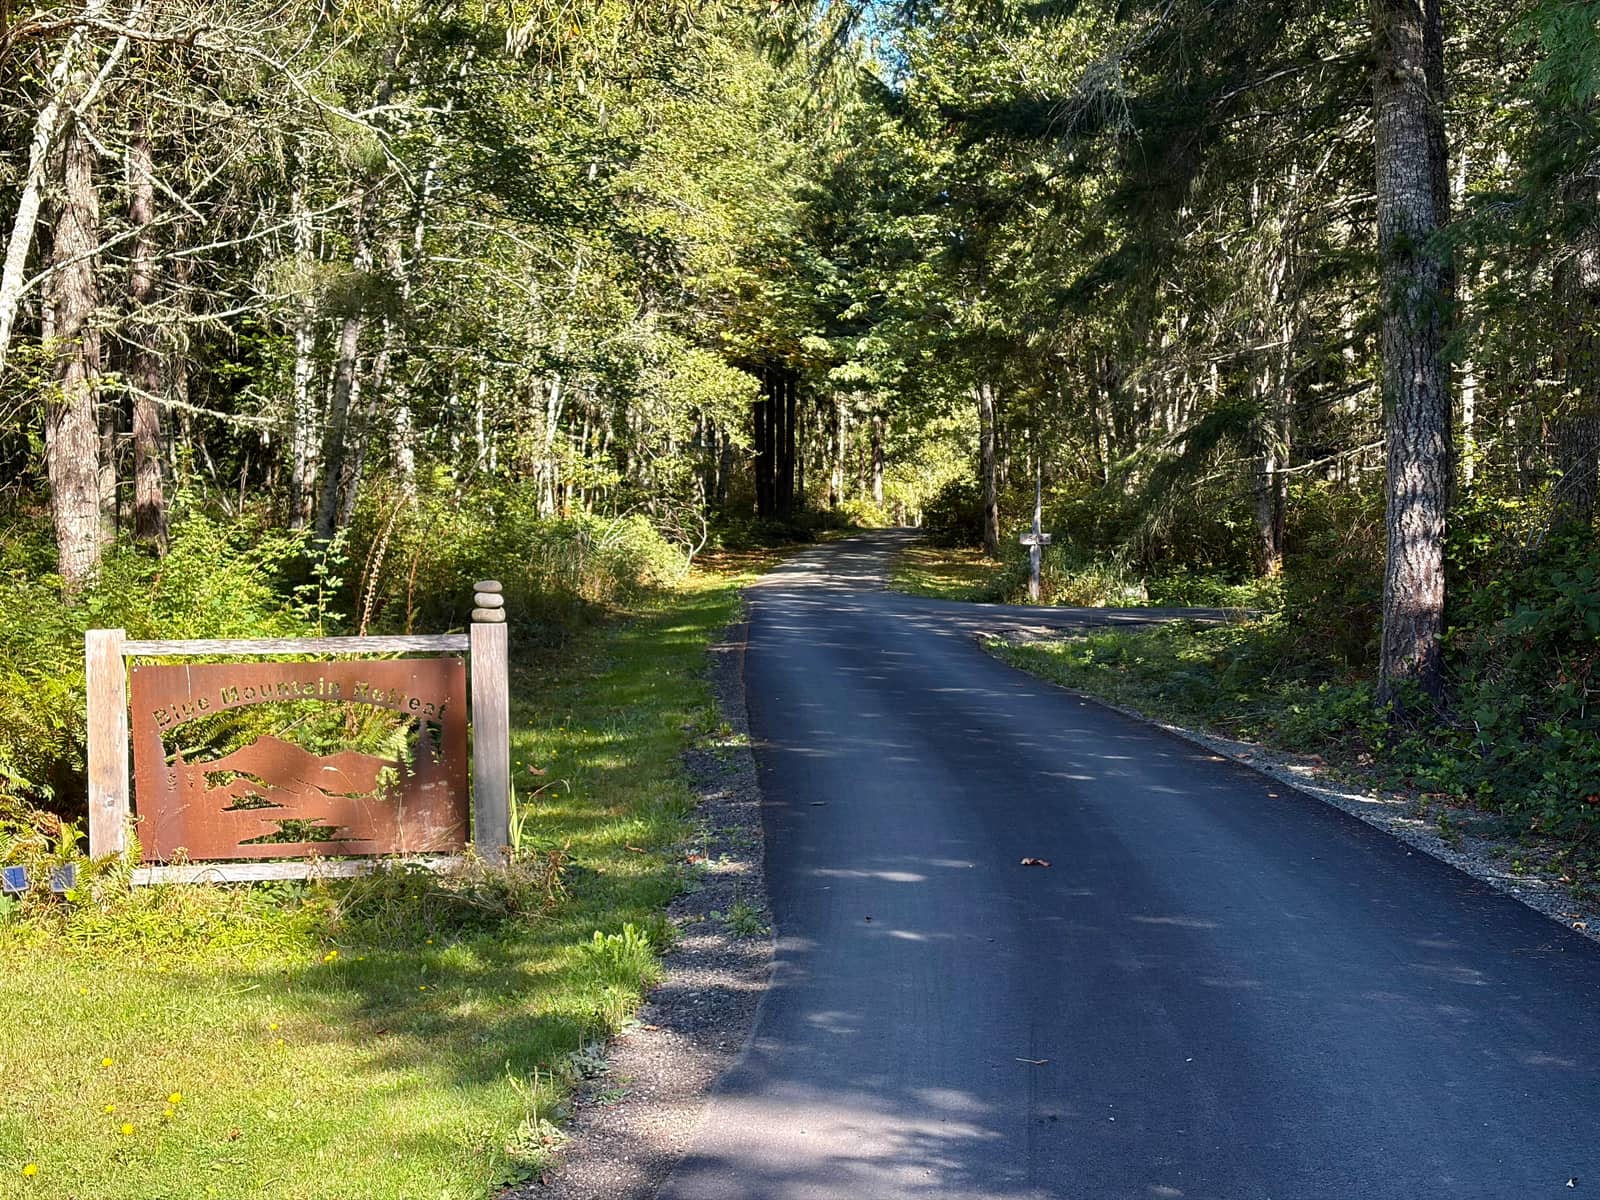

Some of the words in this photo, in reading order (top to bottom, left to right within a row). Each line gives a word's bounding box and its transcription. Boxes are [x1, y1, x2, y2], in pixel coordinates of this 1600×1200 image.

[152, 697, 210, 727] Blue
[220, 676, 341, 705] Mountain
[353, 680, 448, 720] Retreat
